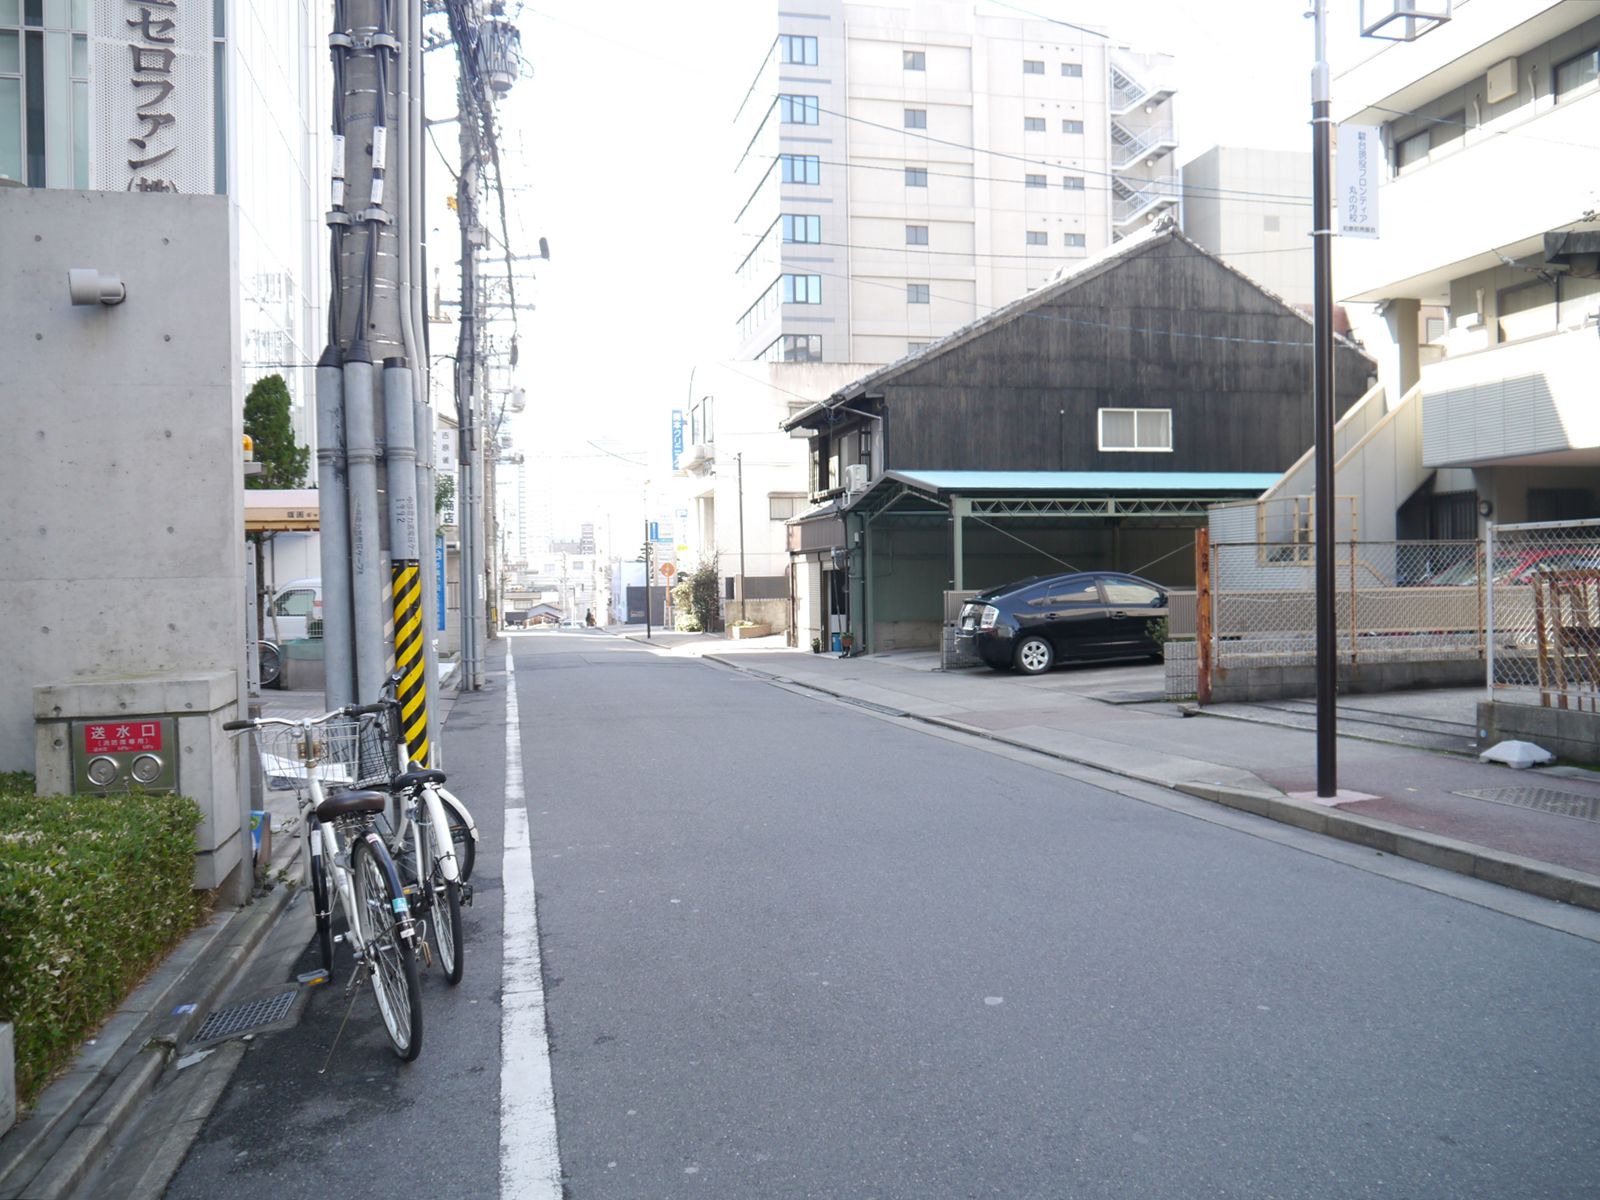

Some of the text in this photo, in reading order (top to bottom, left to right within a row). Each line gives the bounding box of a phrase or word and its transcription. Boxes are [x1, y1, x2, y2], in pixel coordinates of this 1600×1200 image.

[126, 0, 179, 193] セロファン
[91, 724, 155, 740] 送水口
